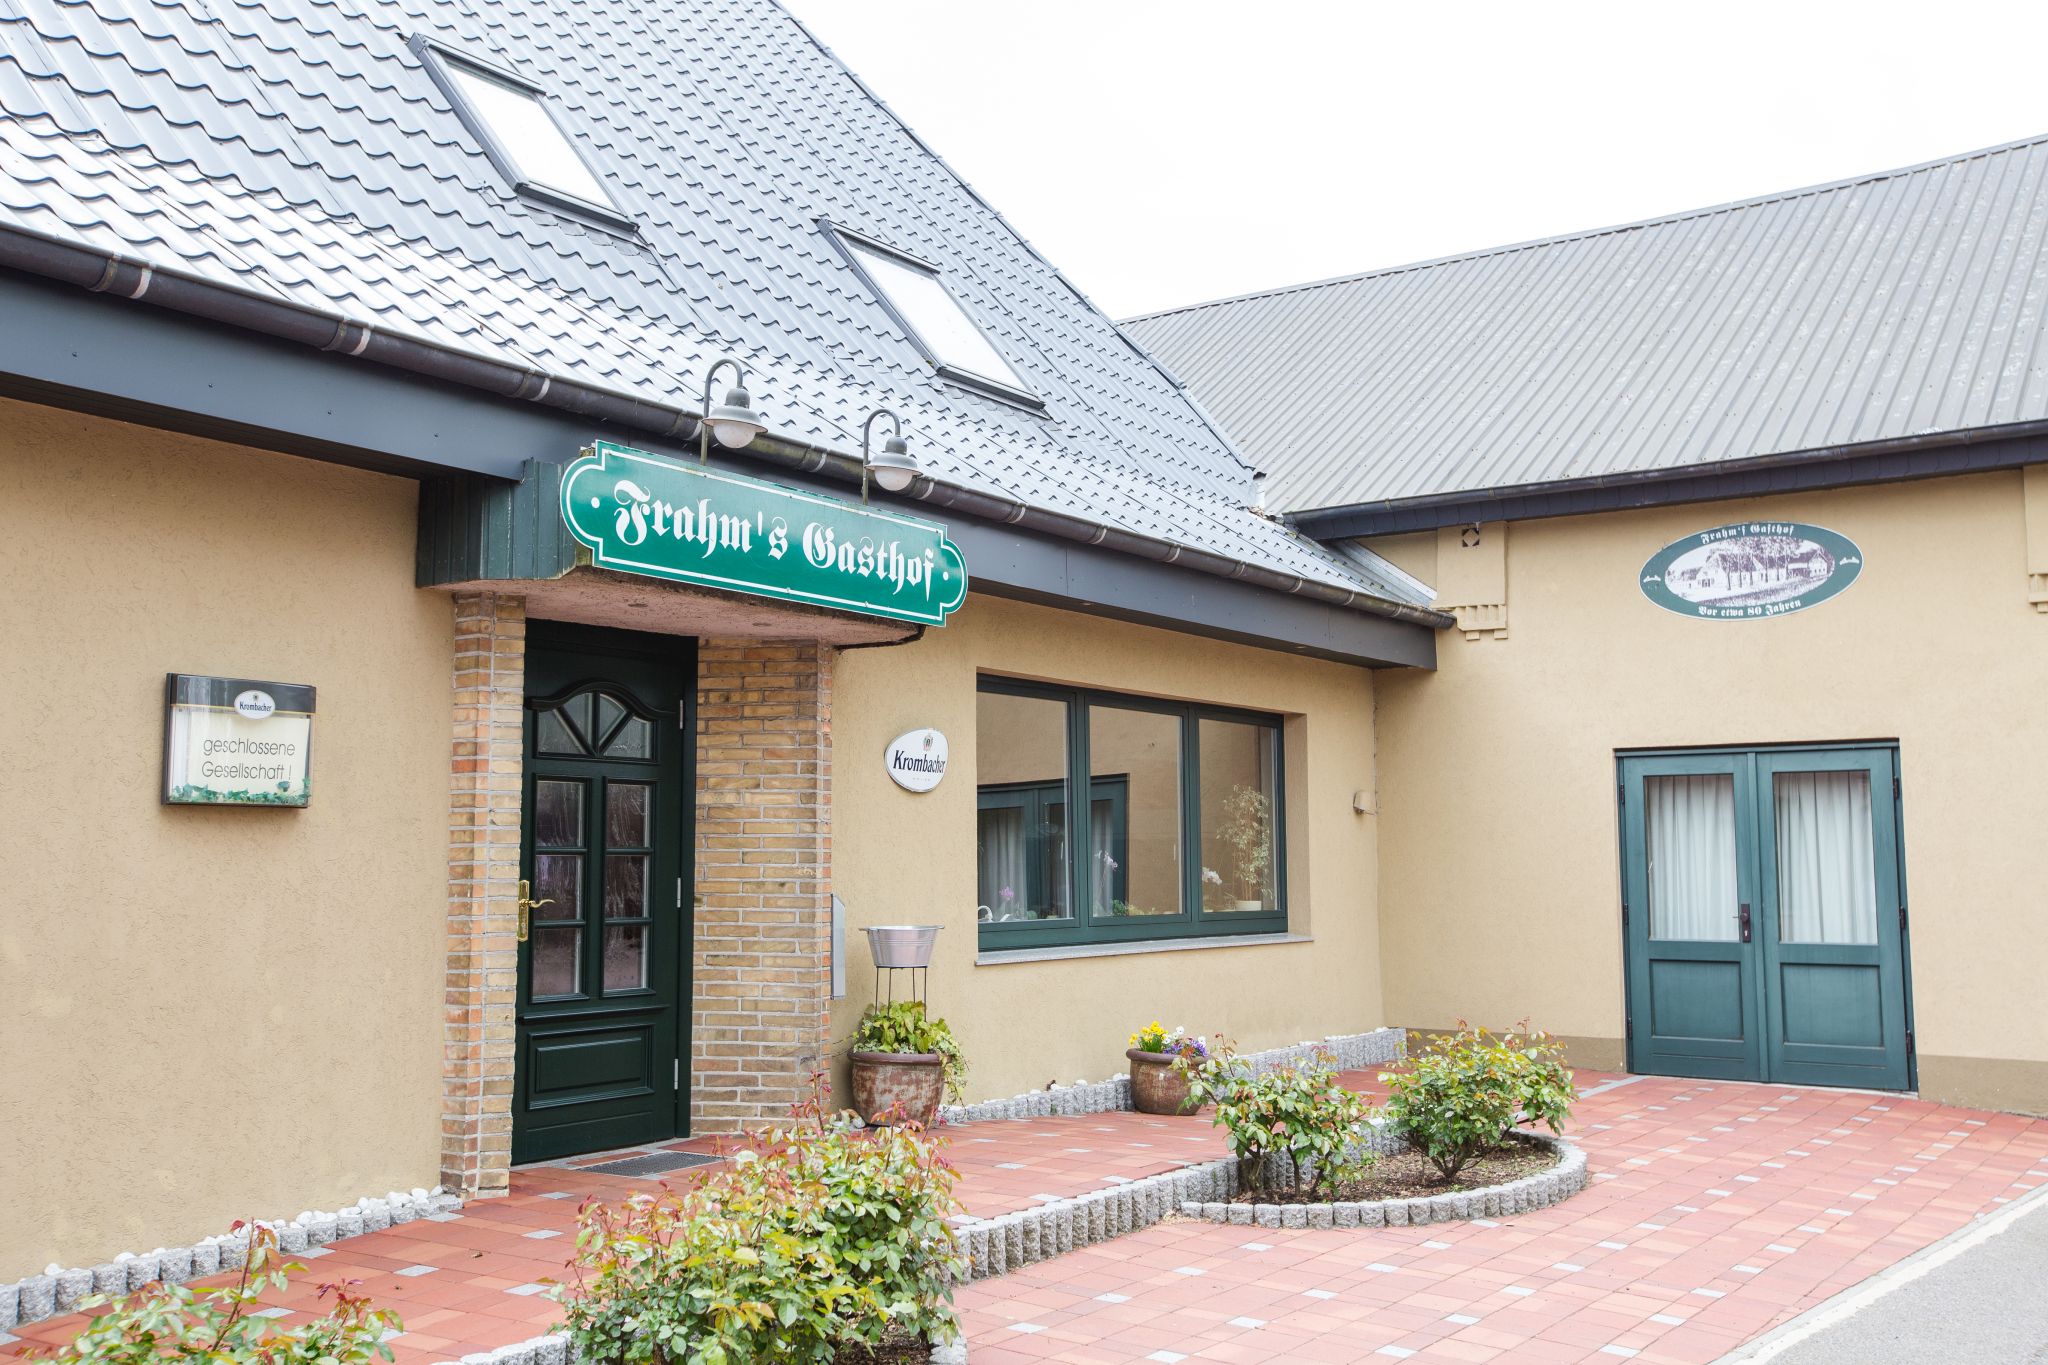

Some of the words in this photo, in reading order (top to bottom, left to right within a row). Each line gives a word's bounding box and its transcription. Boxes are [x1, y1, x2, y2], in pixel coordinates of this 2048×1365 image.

[613, 479, 789, 560] Frahm's
[802, 521, 935, 602] Gasthof
[1698, 606, 1718, 616] Vor
[1721, 608, 1744, 617] etwa
[1747, 607, 1762, 615] 80
[1765, 599, 1802, 616] Jahren
[239, 701, 272, 712] Krombacher
[203, 738, 295, 756] geschlossene
[202, 761, 284, 780] Gesellschaft
[893, 749, 946, 774] Krombacher
